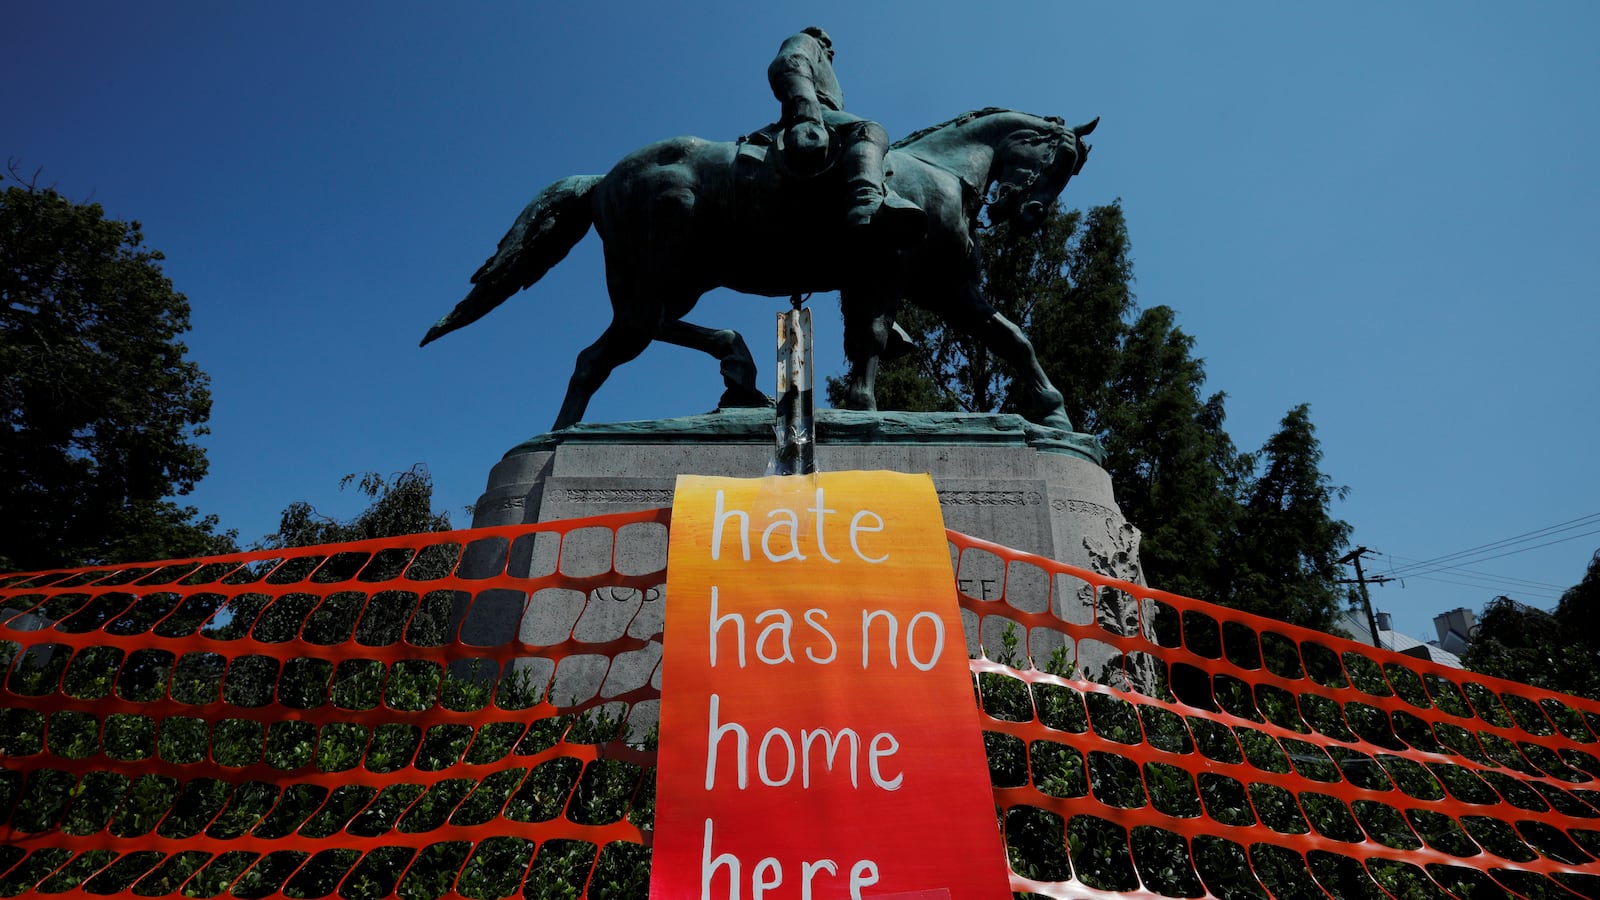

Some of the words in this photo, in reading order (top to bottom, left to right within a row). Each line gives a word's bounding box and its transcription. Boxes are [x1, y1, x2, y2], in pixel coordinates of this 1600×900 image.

[711, 488, 889, 564] hate
[709, 586, 837, 669] has
[862, 609, 945, 671] no
[705, 694, 904, 791] home
[701, 818, 879, 900] here
